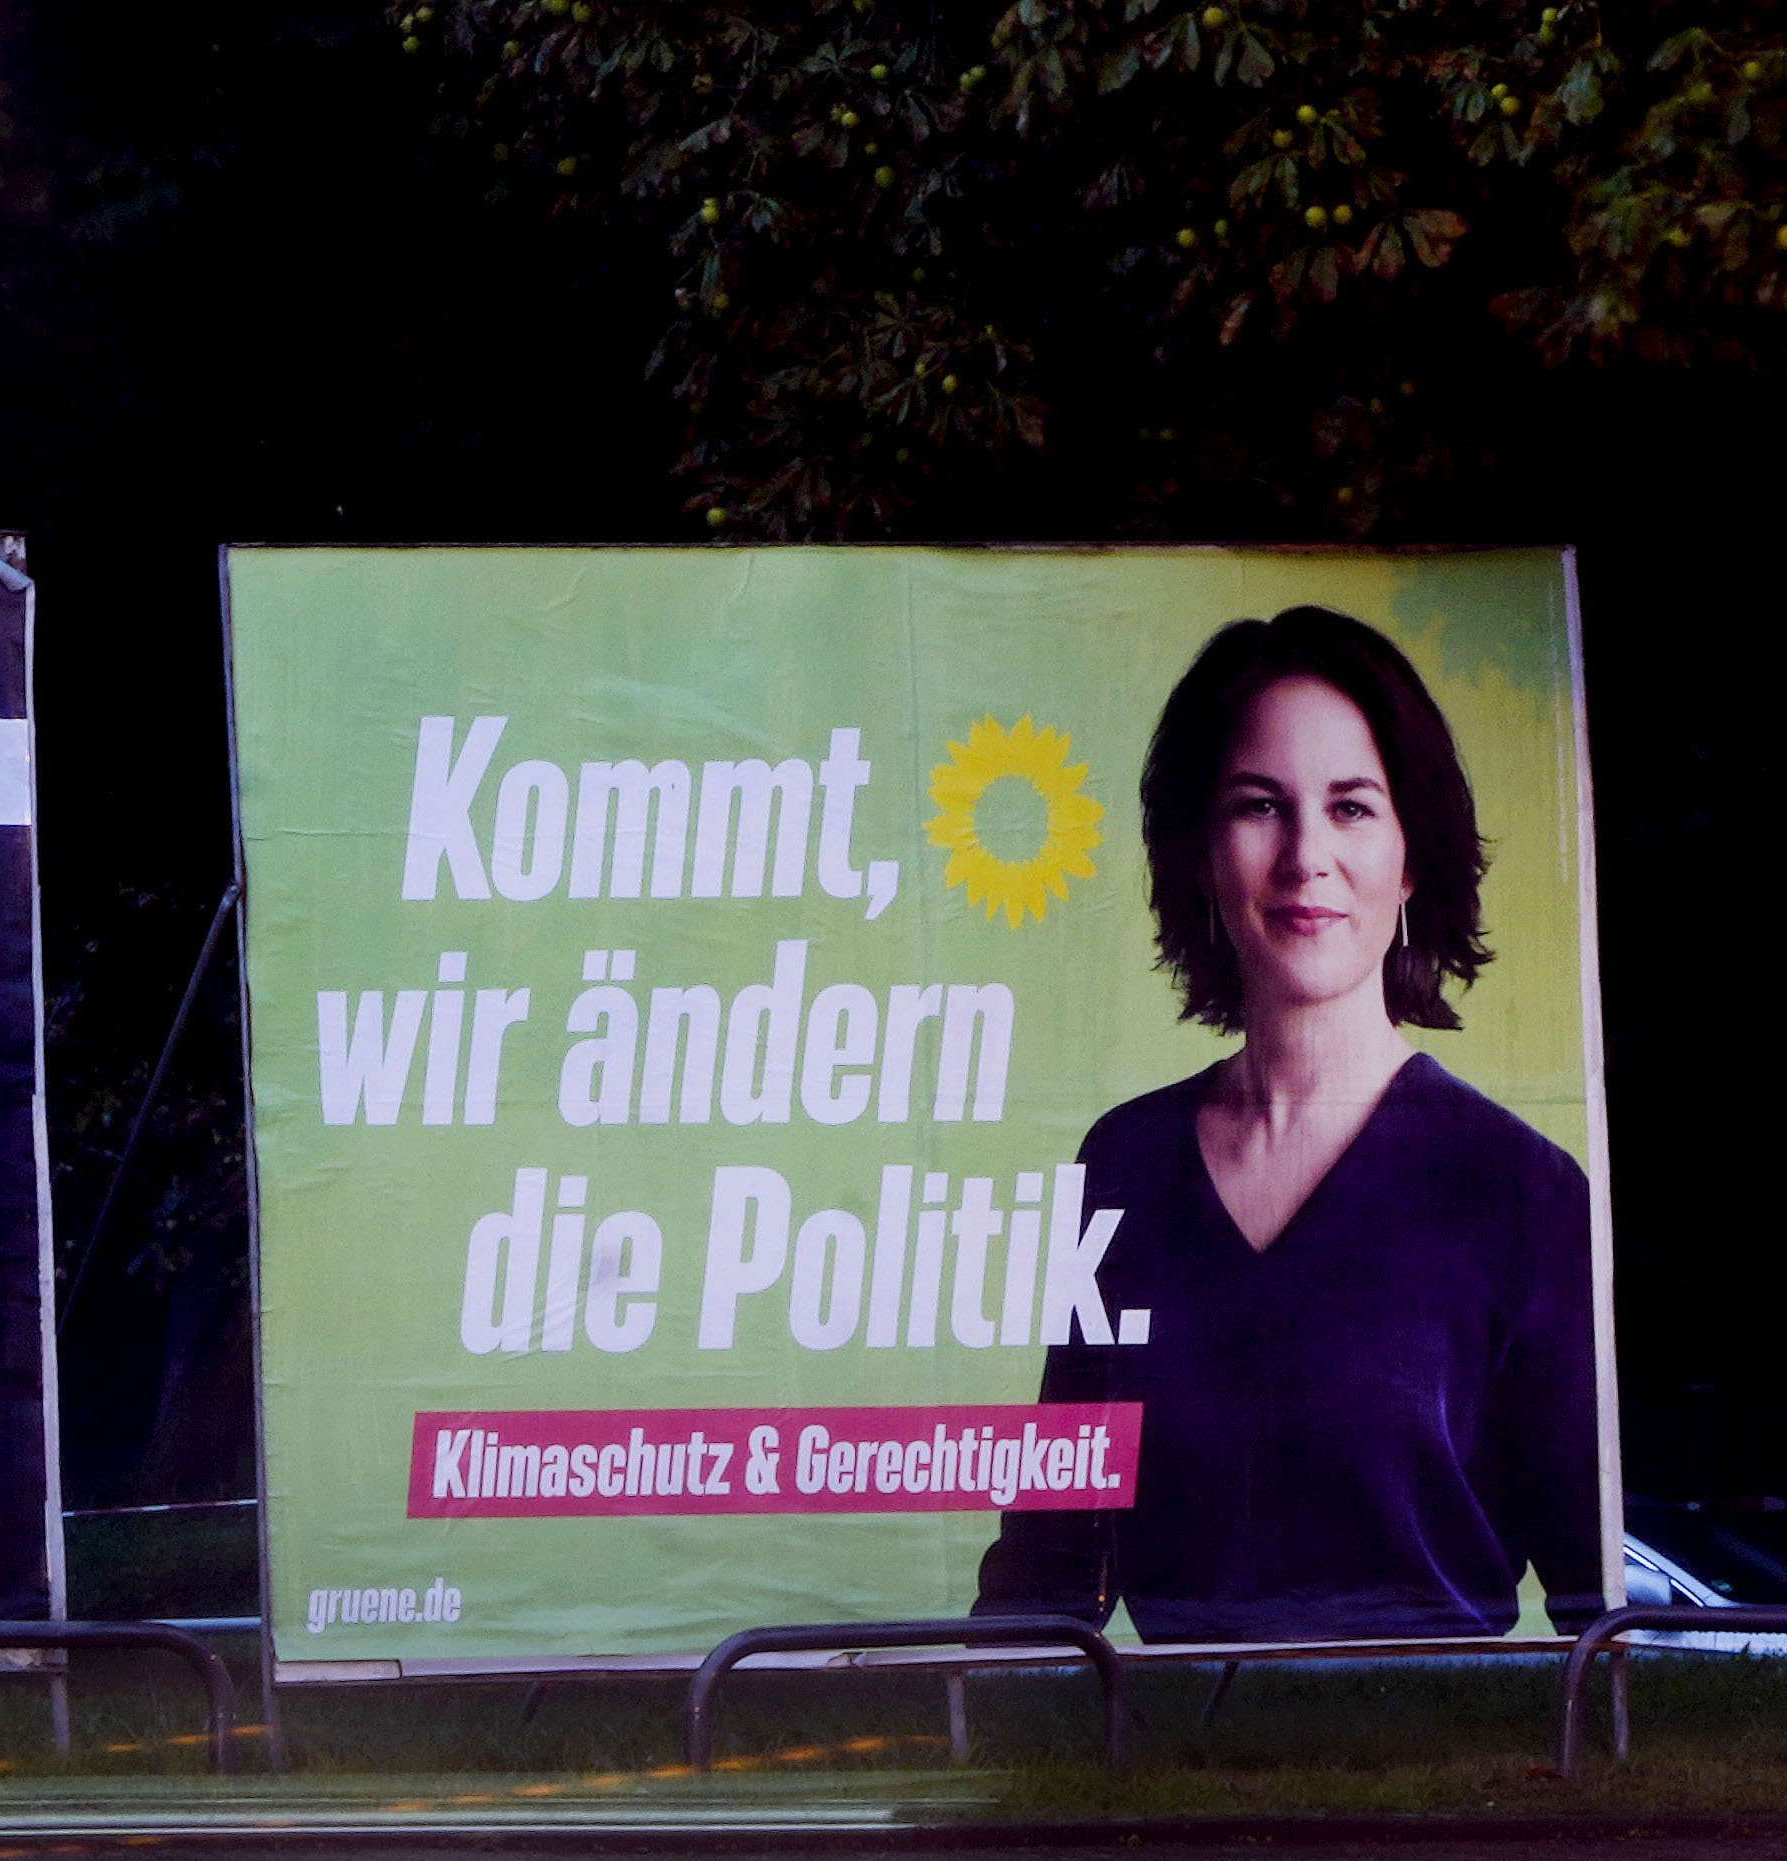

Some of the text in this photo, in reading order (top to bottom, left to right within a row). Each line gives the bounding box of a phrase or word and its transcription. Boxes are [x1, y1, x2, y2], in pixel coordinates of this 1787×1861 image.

[400, 714, 900, 920] Kommt,
[317, 940, 1015, 1126] wir ändern
[460, 1164, 1152, 1354] die Politik.
[430, 1420, 1122, 1508] Klimaschutz & Gerechtigkeit.
[306, 1577, 463, 1634] gruene.de
